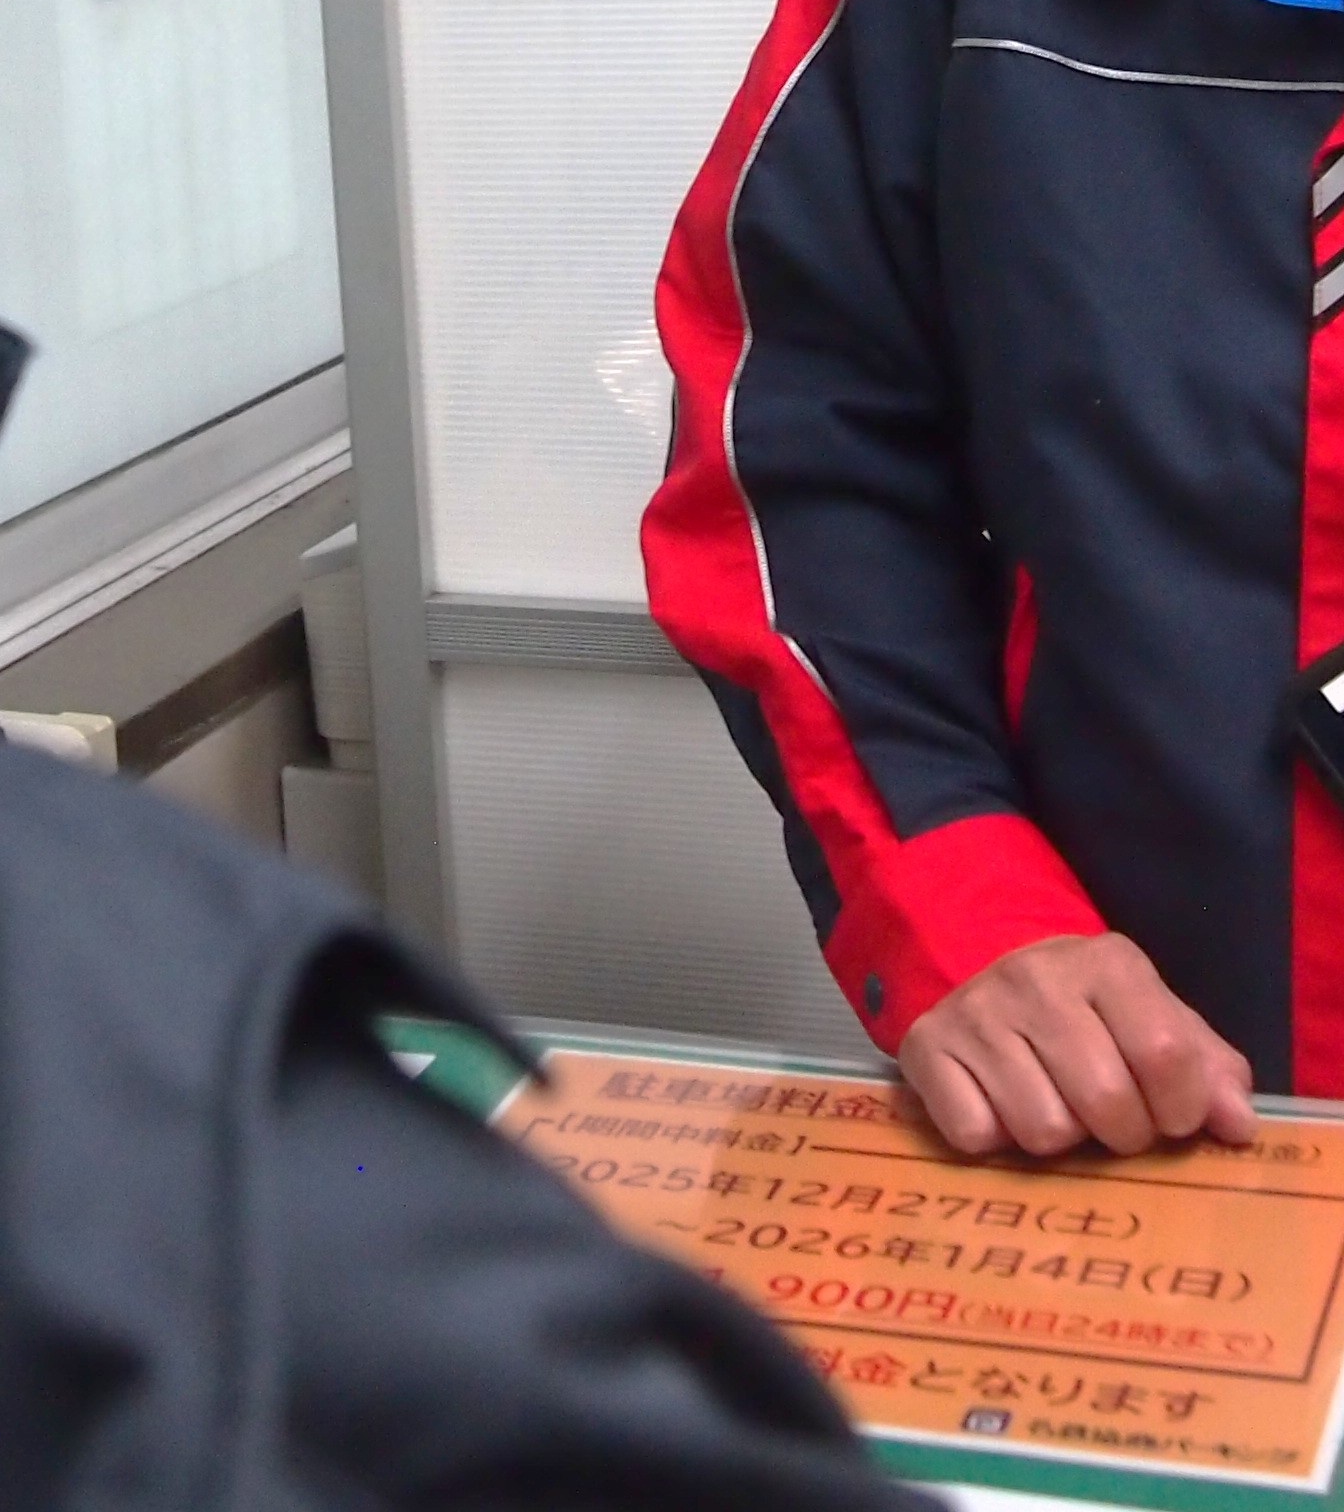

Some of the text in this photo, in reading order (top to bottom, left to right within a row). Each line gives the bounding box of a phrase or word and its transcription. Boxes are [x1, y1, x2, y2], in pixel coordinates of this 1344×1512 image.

[599, 1071, 905, 1121] 駐車場料金
